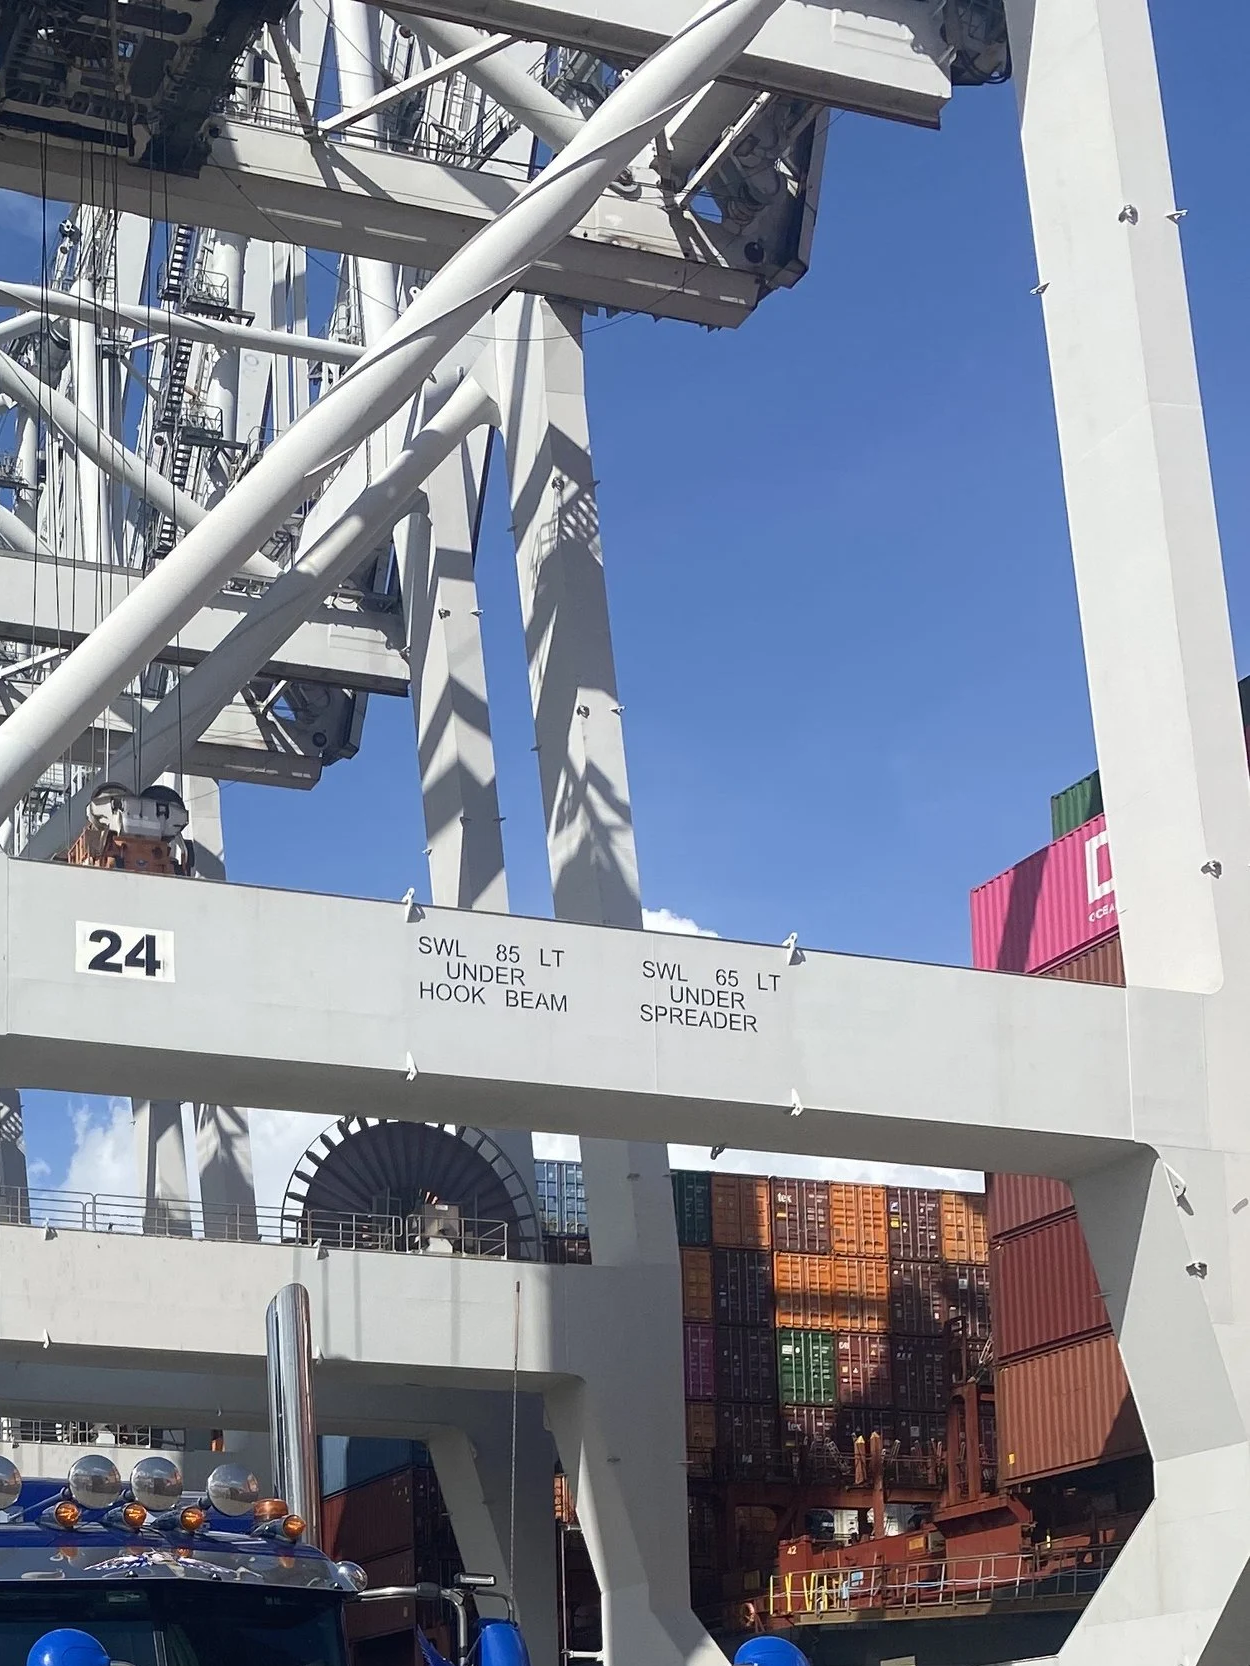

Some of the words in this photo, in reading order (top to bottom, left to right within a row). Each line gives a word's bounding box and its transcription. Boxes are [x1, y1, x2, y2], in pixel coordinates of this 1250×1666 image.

[88, 929, 161, 977] 24
[418, 936, 467, 958] SWL
[496, 944, 520, 964] 85
[540, 948, 565, 968] LT
[446, 961, 526, 986] UNDER
[642, 960, 689, 982] SWL
[715, 969, 739, 988] 65
[757, 973, 781, 992] LT
[419, 981, 486, 1005] HOOK
[505, 989, 568, 1012] BEAM
[670, 985, 746, 1010] UNDER
[640, 1004, 758, 1033] SPREADER
